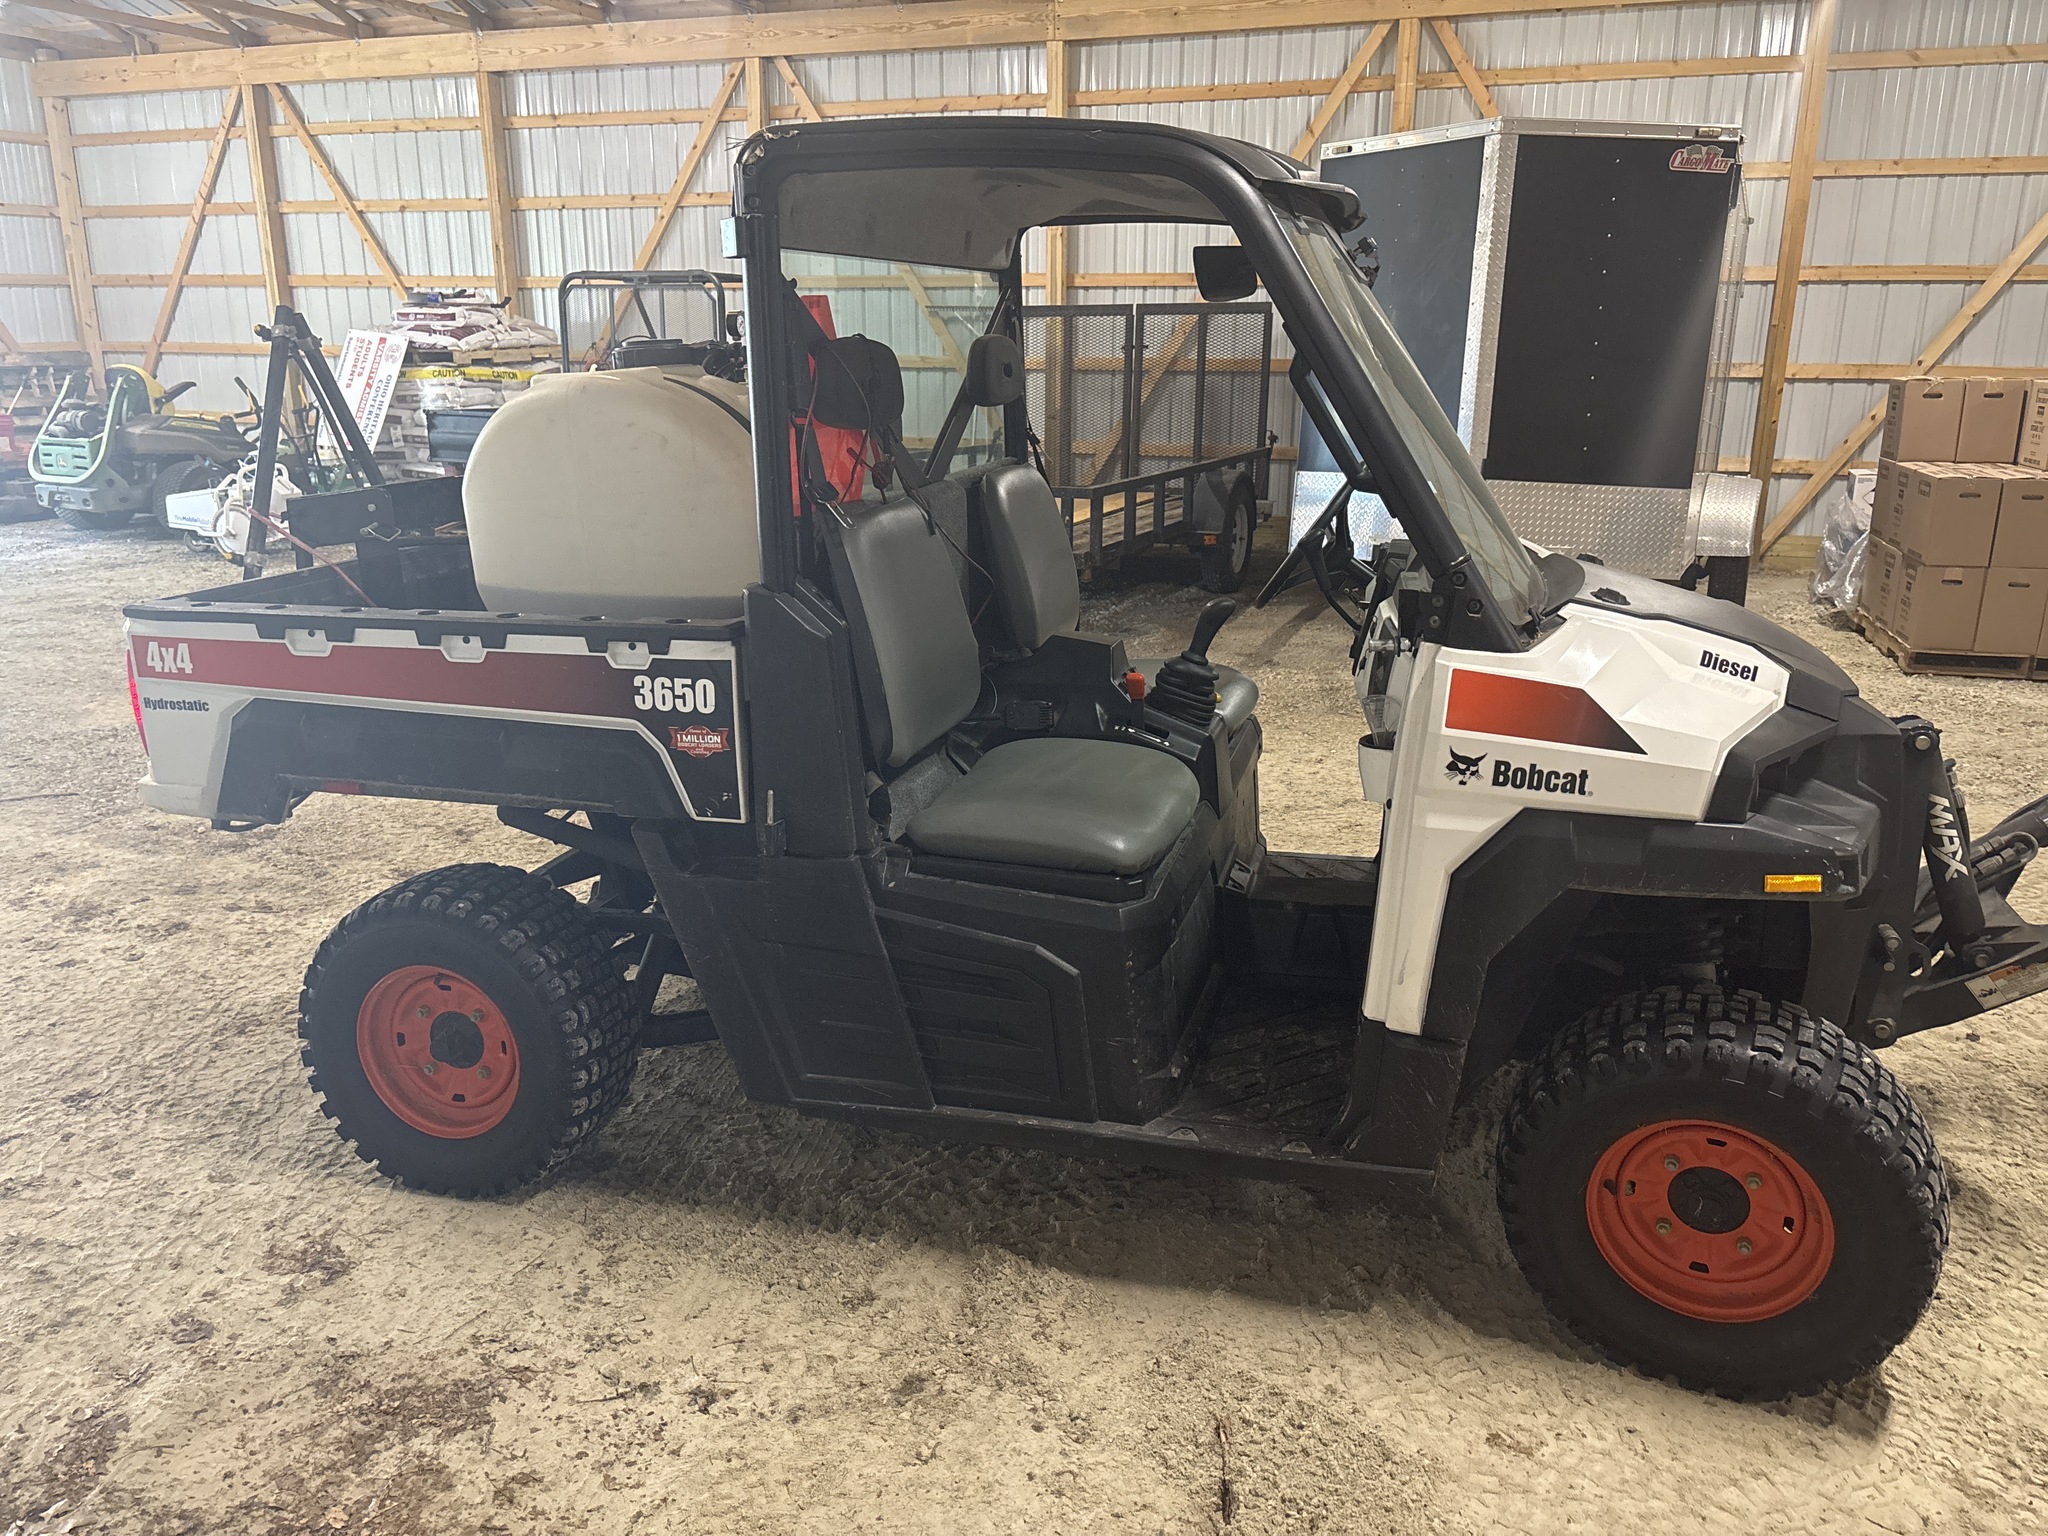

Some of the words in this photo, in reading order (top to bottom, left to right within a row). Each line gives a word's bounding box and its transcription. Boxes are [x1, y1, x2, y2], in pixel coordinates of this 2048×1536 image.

[345, 337, 366, 389] STUDENTS
[357, 339, 373, 378] ADULTS
[367, 344, 387, 385] VARSITY
[432, 368, 466, 379] CAUTION
[492, 370, 518, 380] CAUTION
[382, 374, 393, 398] OHIO
[355, 386, 371, 426] ADMISS
[361, 379, 383, 435] CONFERENC
[146, 641, 193, 674] 4x4
[1699, 649, 1759, 682] Diesel
[143, 697, 209, 712] Hydrostatic
[633, 675, 715, 714] 3650
[682, 735, 721, 743] MILLION
[1492, 759, 1589, 795] Bobcat
[1928, 793, 1969, 883] MAX
